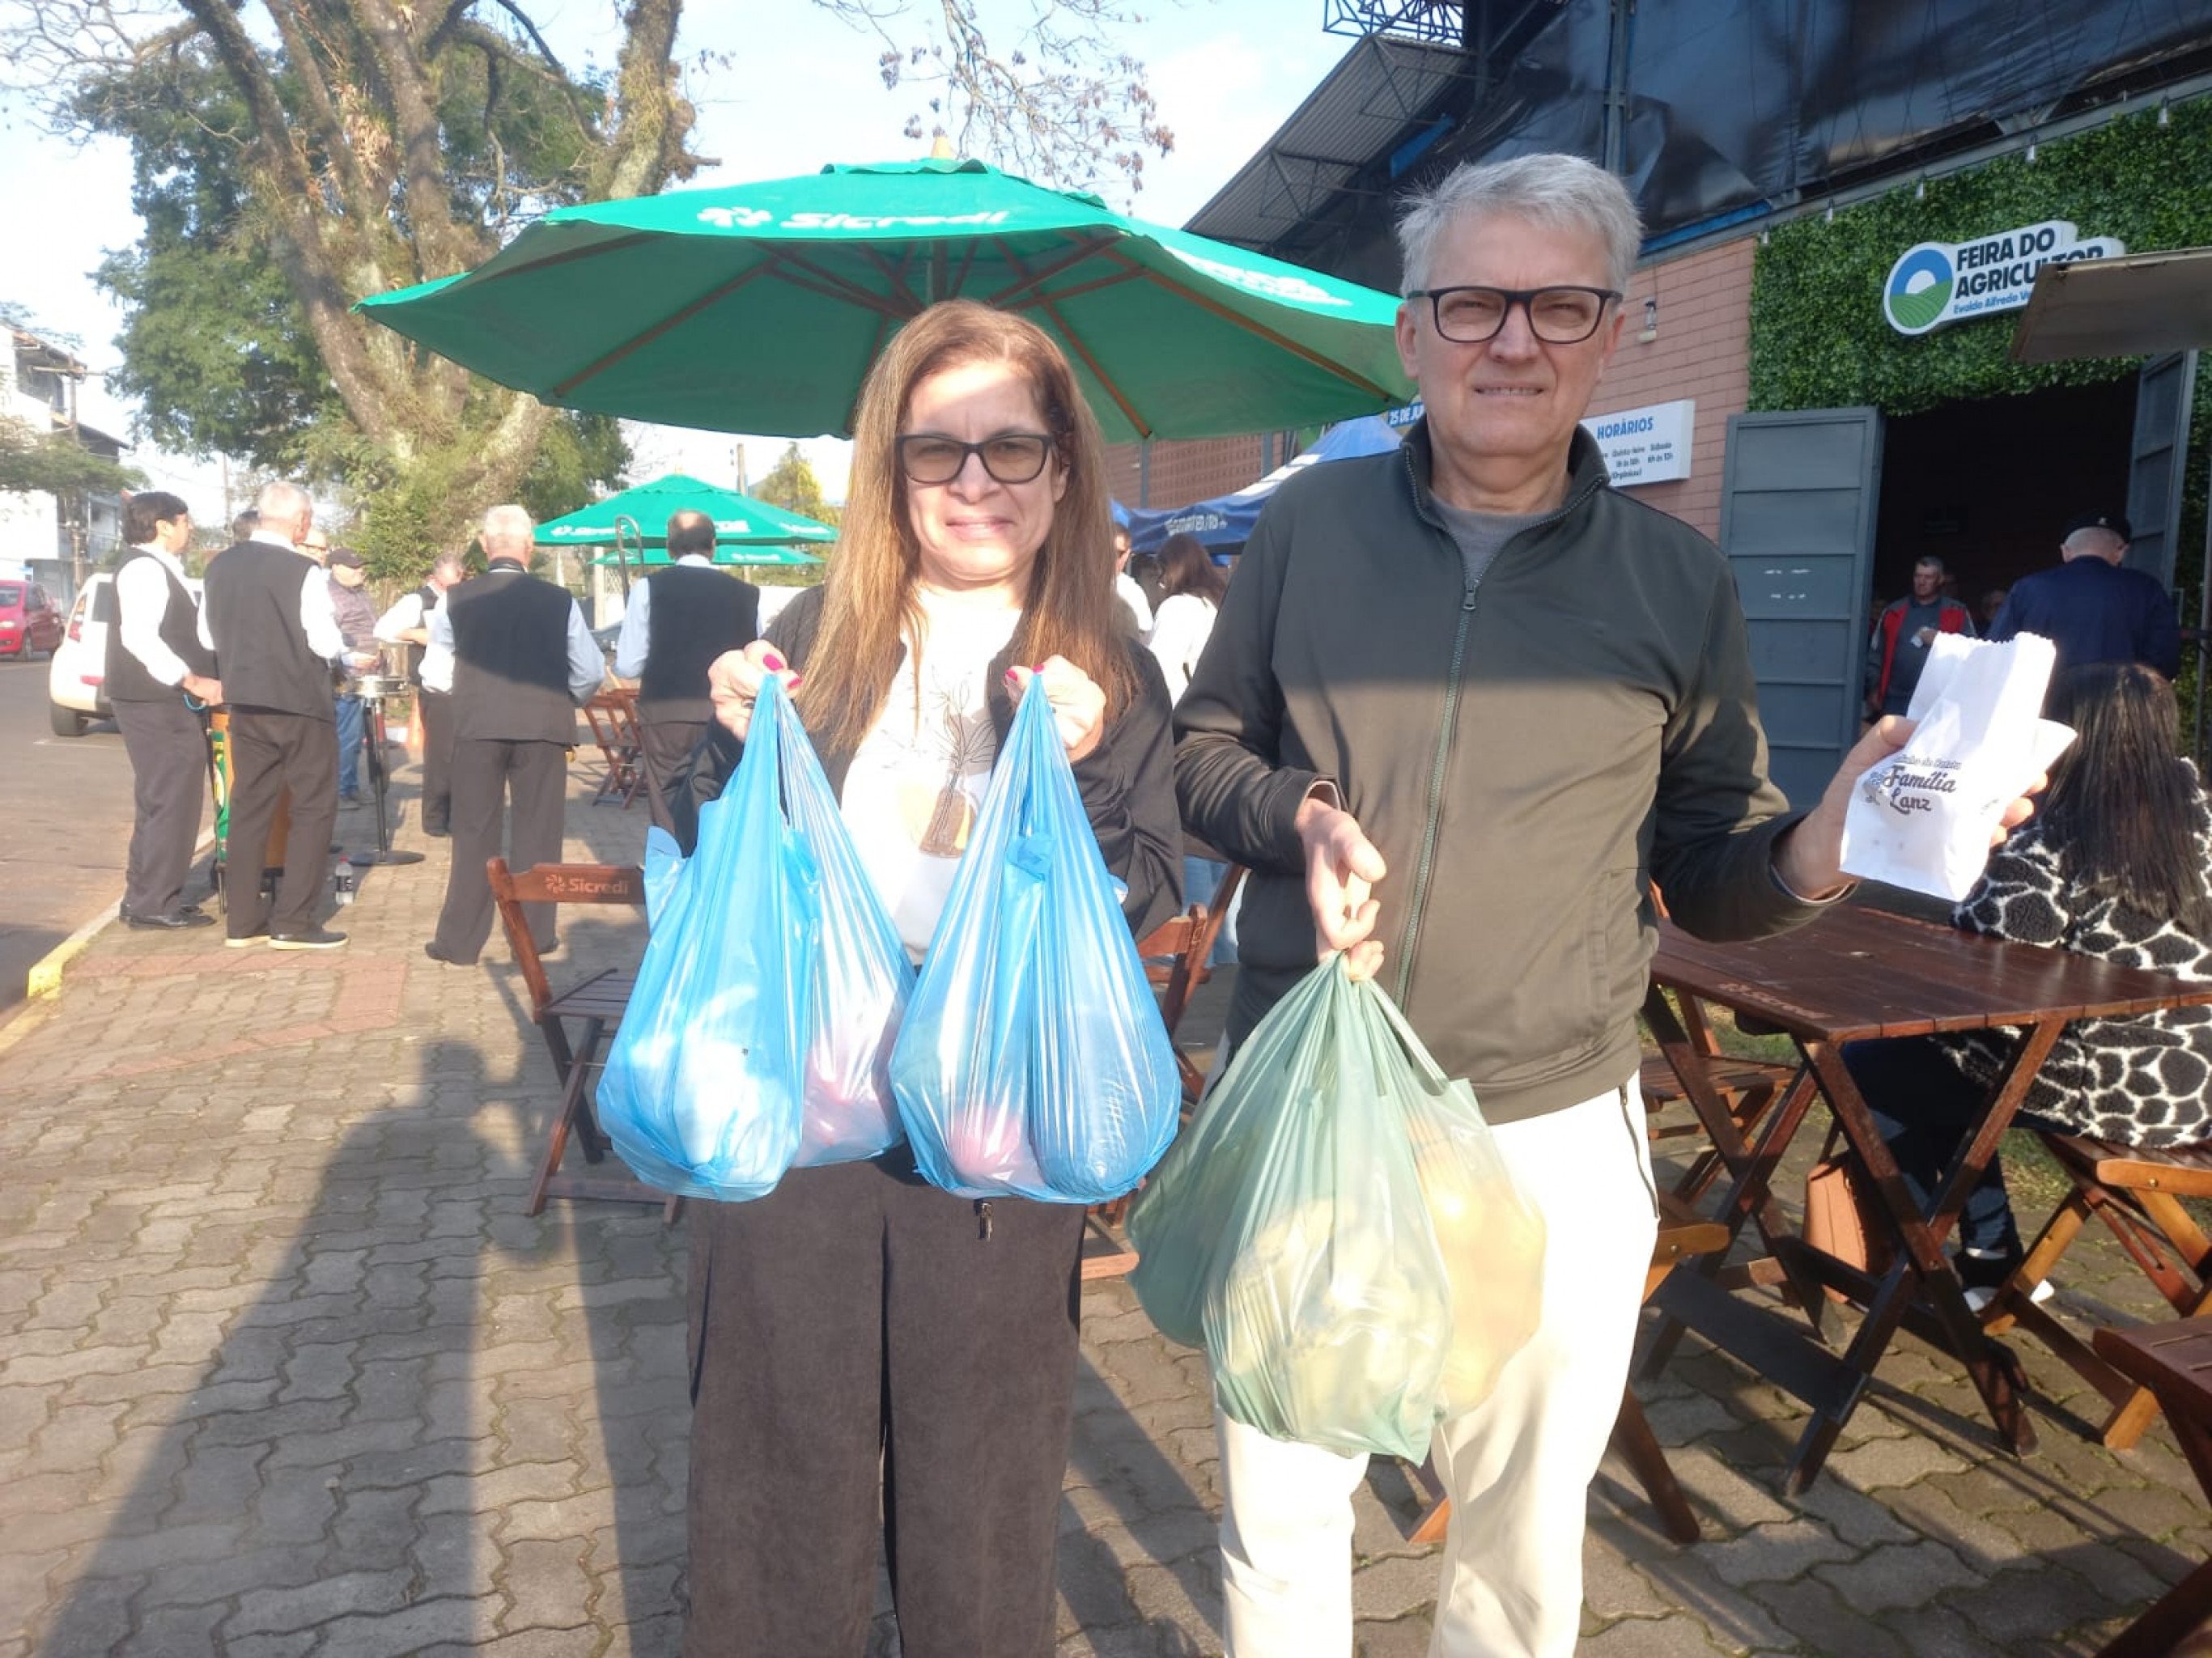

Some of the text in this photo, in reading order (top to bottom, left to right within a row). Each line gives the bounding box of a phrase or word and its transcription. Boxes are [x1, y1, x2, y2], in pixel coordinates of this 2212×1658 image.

[1956, 227, 2055, 272] FEIRA DO
[1955, 245, 2104, 299] AGRICUR
[1597, 416, 1654, 440] HORÁRIOS
[1883, 765, 1957, 793] Família
[567, 877, 629, 896] Sicredi
